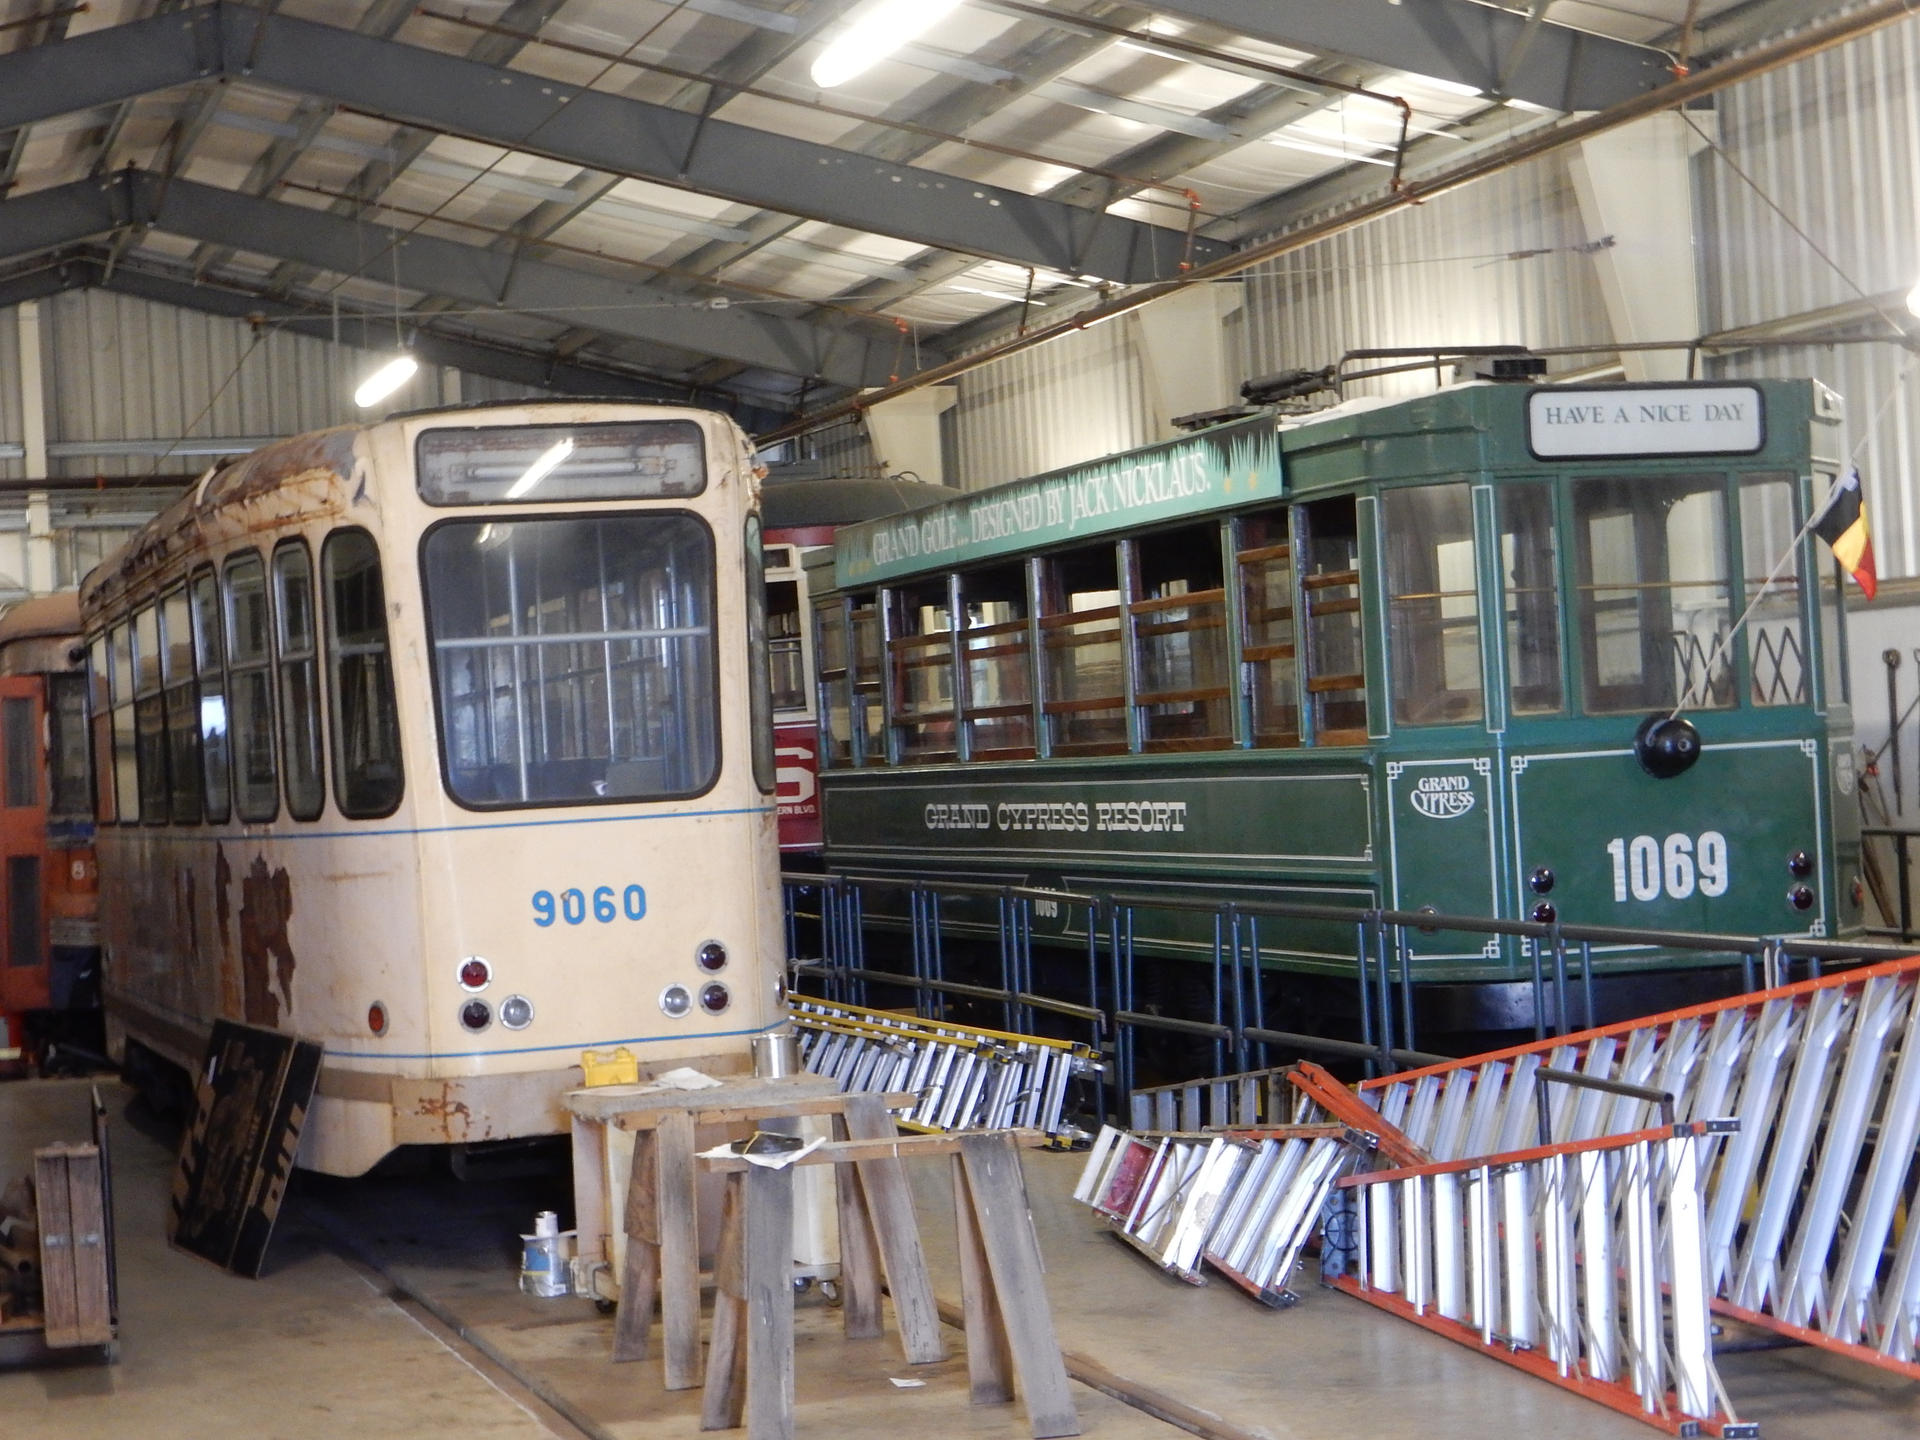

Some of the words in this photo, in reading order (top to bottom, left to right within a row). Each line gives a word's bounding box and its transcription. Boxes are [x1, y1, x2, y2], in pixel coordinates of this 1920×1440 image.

[1546, 406, 1604, 425] HAVE
[1613, 405, 1630, 424] A
[1640, 404, 1691, 423] NICE
[1704, 403, 1745, 422] DAY
[872, 523, 920, 566] GRAND
[969, 492, 1043, 544] DESIGNED
[1045, 485, 1066, 527] BY
[1068, 474, 1112, 532] JACK
[1111, 451, 1212, 512] NICKLAUS.
[1418, 775, 1470, 792] GRAND
[924, 802, 992, 830] GRAND
[996, 801, 1090, 832] CYPRESS
[1095, 800, 1188, 833] RESORT
[1410, 789, 1476, 819] CYPRESS
[1606, 830, 1729, 903] 1069
[531, 883, 647, 928] 9060
